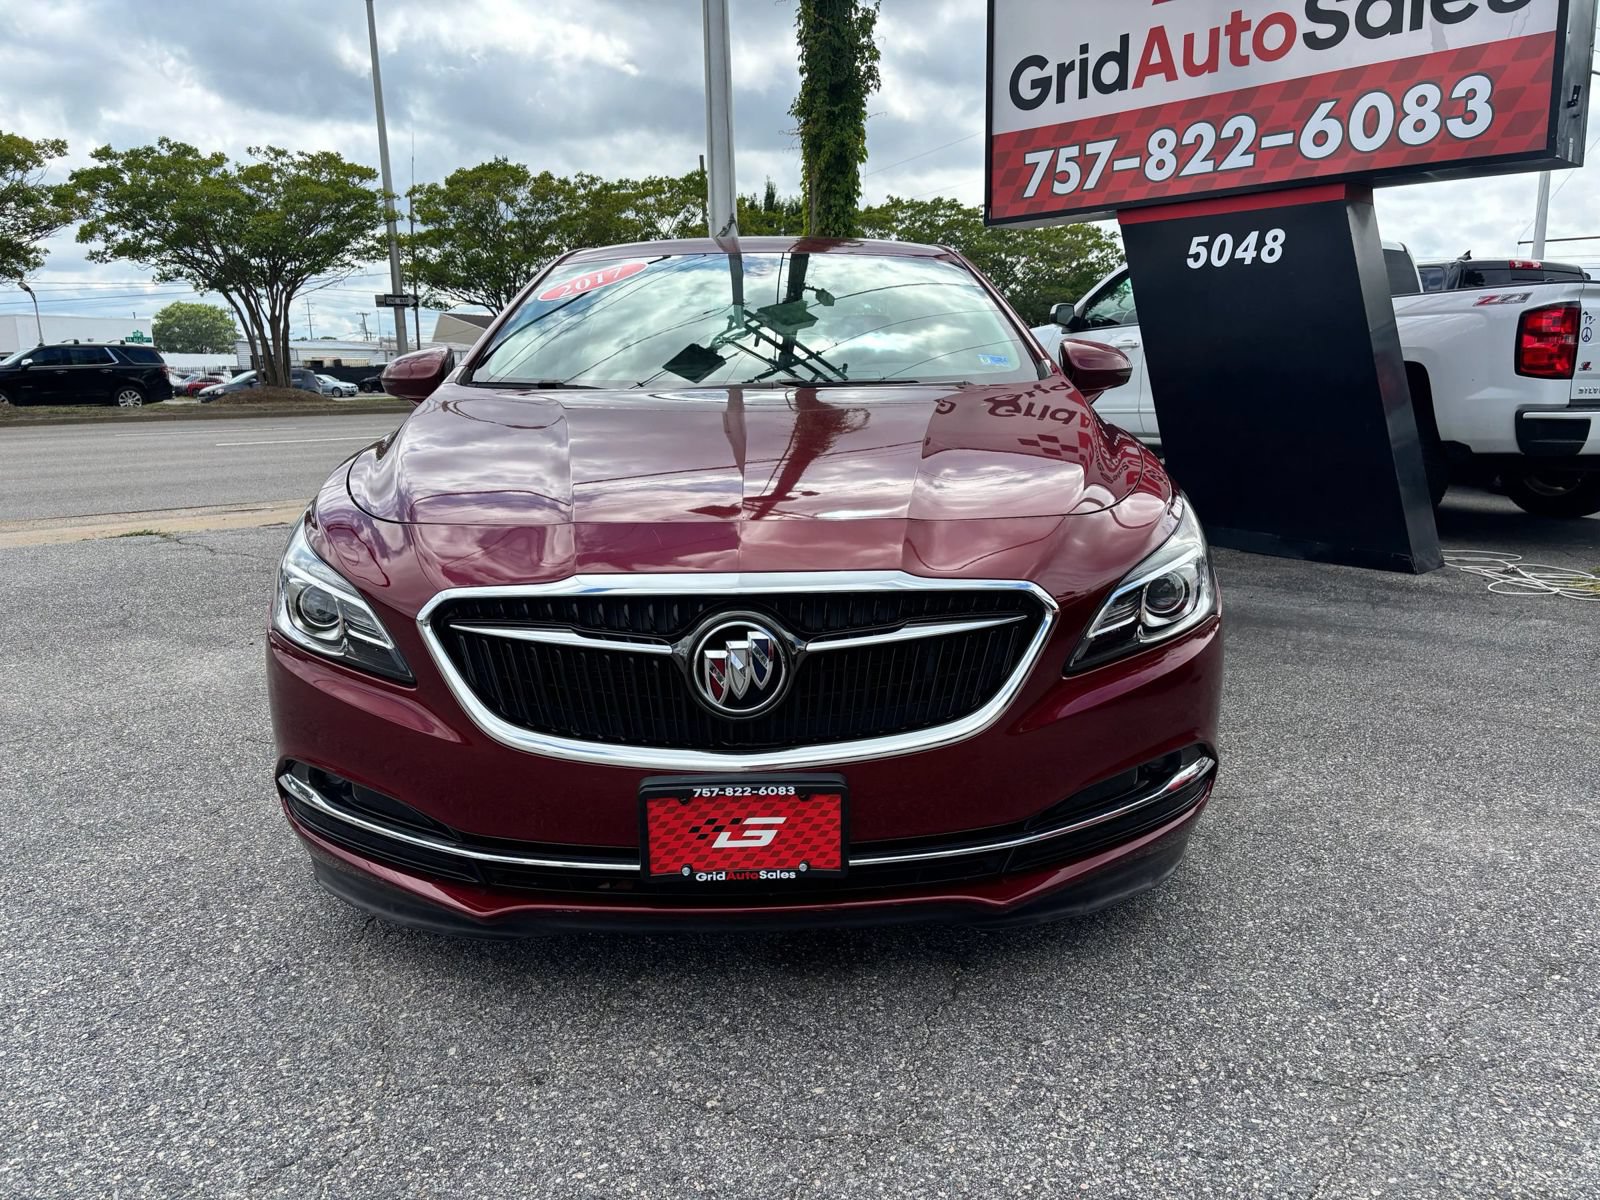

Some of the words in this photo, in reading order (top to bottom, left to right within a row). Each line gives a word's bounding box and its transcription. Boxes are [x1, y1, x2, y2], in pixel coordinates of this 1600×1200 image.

[1022, 73, 1493, 198] 757-822-6083
[1186, 228, 1286, 269] 5048
[558, 267, 623, 297] 2017
[1472, 291, 1534, 308] Z71
[693, 786, 796, 797] 757-822-6083
[695, 869, 796, 882] GridAutoSales
